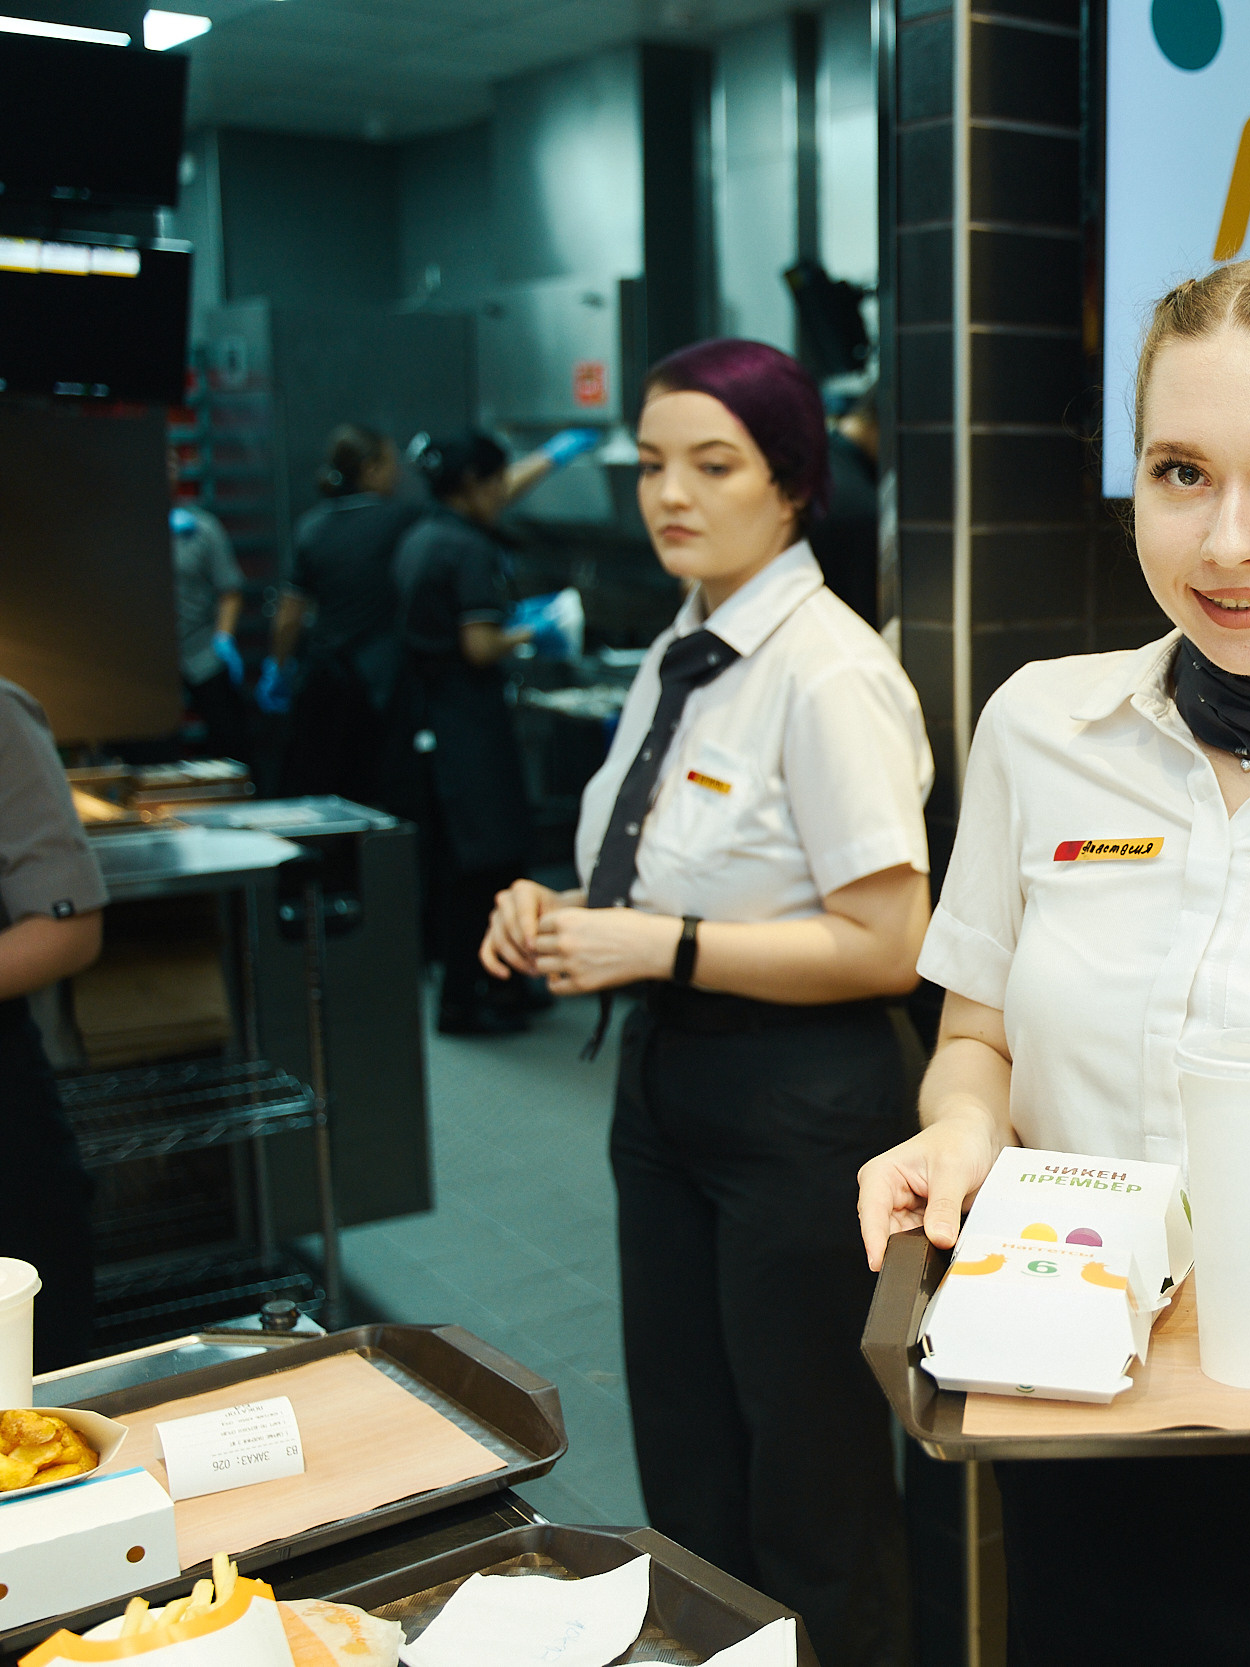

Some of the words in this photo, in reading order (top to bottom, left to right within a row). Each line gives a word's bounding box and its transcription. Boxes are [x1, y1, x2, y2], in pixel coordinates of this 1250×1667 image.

[1045, 1165, 1127, 1181] ЧИКЕН
[1020, 1173, 1142, 1193] ПРЕМЬЕР
[1027, 1260, 1058, 1274] 6
[212, 1459, 231, 1472] 026
